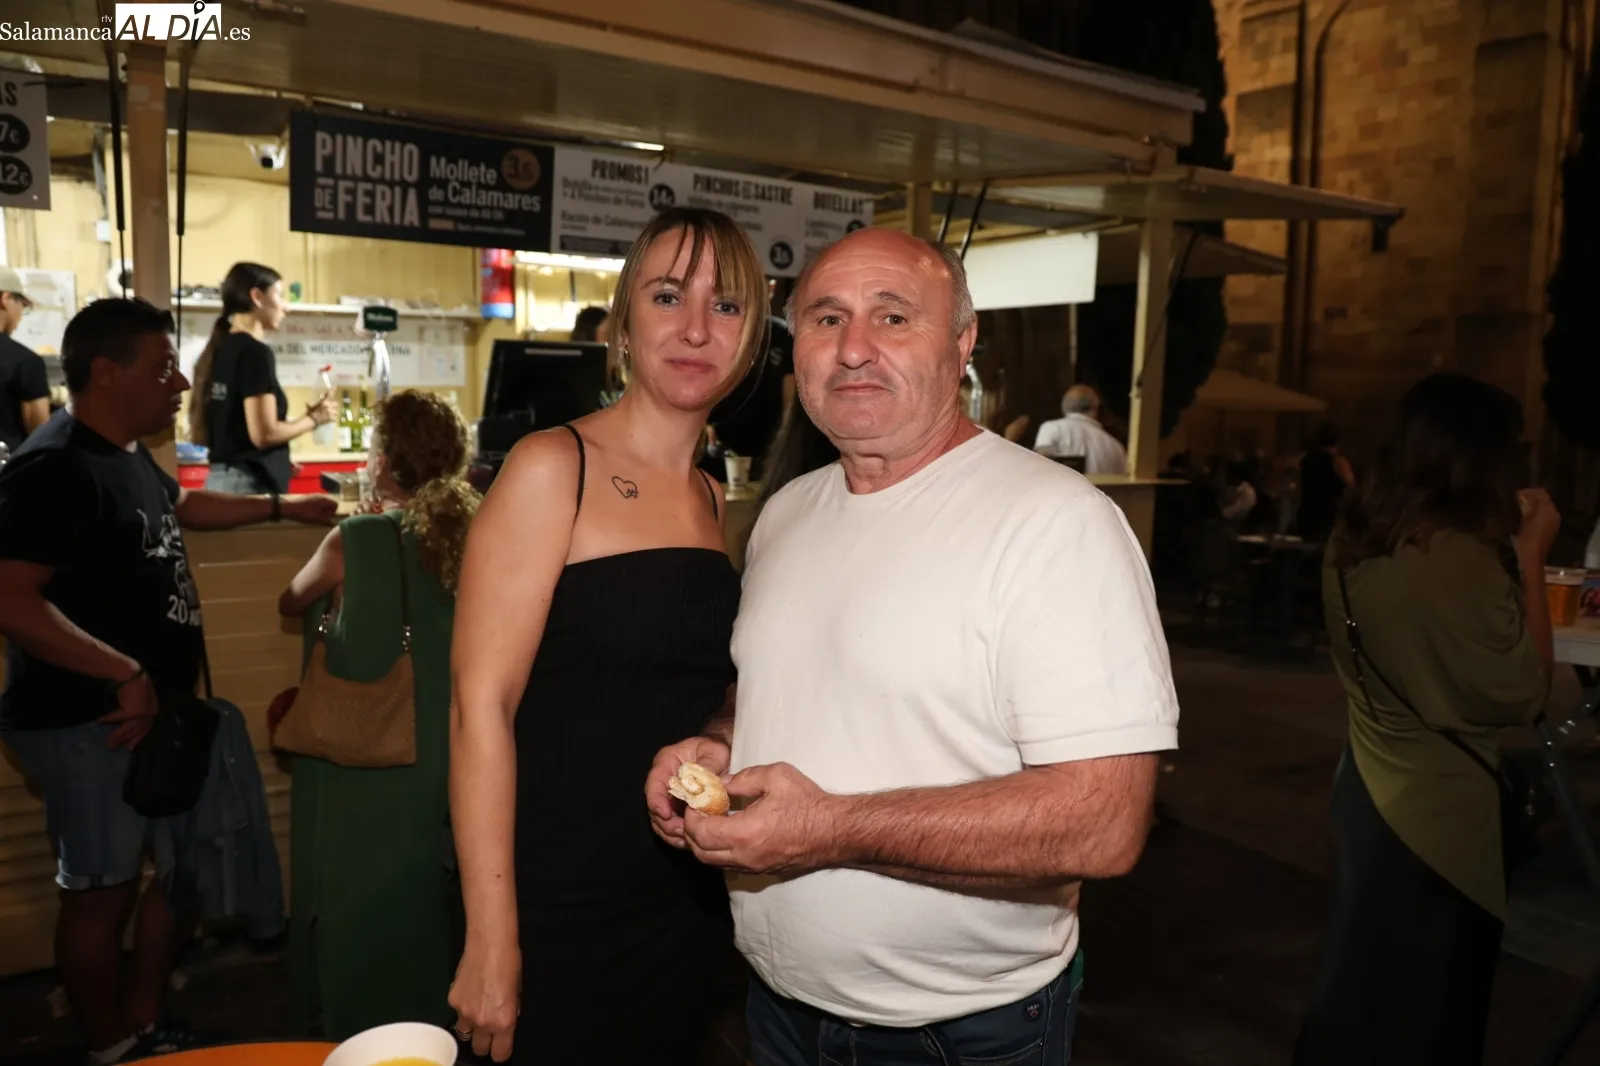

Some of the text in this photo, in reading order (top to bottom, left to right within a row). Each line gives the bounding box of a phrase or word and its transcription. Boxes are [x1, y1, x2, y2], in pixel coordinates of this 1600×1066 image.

[0, 80, 18, 107] S
[314, 130, 420, 183] PINCHO
[429, 155, 498, 186] Mollete
[314, 187, 334, 210] DE
[337, 179, 421, 228] FERIA
[428, 180, 542, 212] de Calamares
[693, 172, 740, 197] PINCHOS
[754, 182, 793, 206] SASTRE
[813, 191, 864, 215] BOTELLAS
[166, 594, 188, 625] 20
